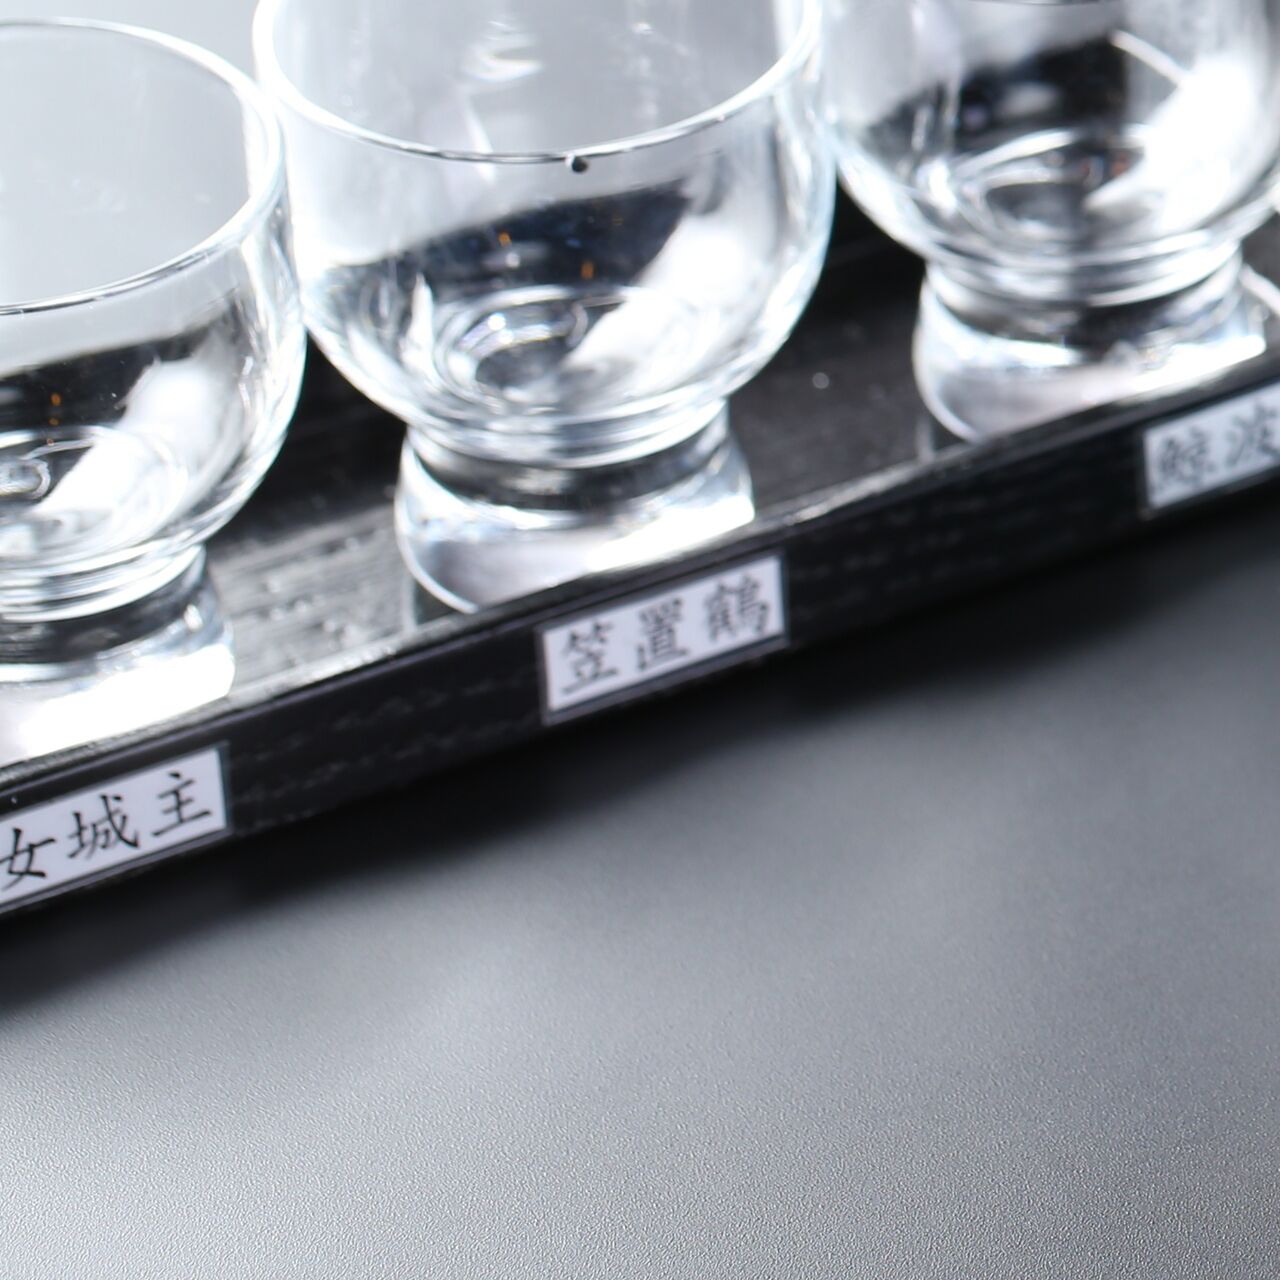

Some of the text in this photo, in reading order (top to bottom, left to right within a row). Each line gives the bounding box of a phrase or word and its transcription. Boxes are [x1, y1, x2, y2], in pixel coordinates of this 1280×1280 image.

[562, 573, 771, 697] 笠置鶴
[0, 773, 212, 891] 女城主
